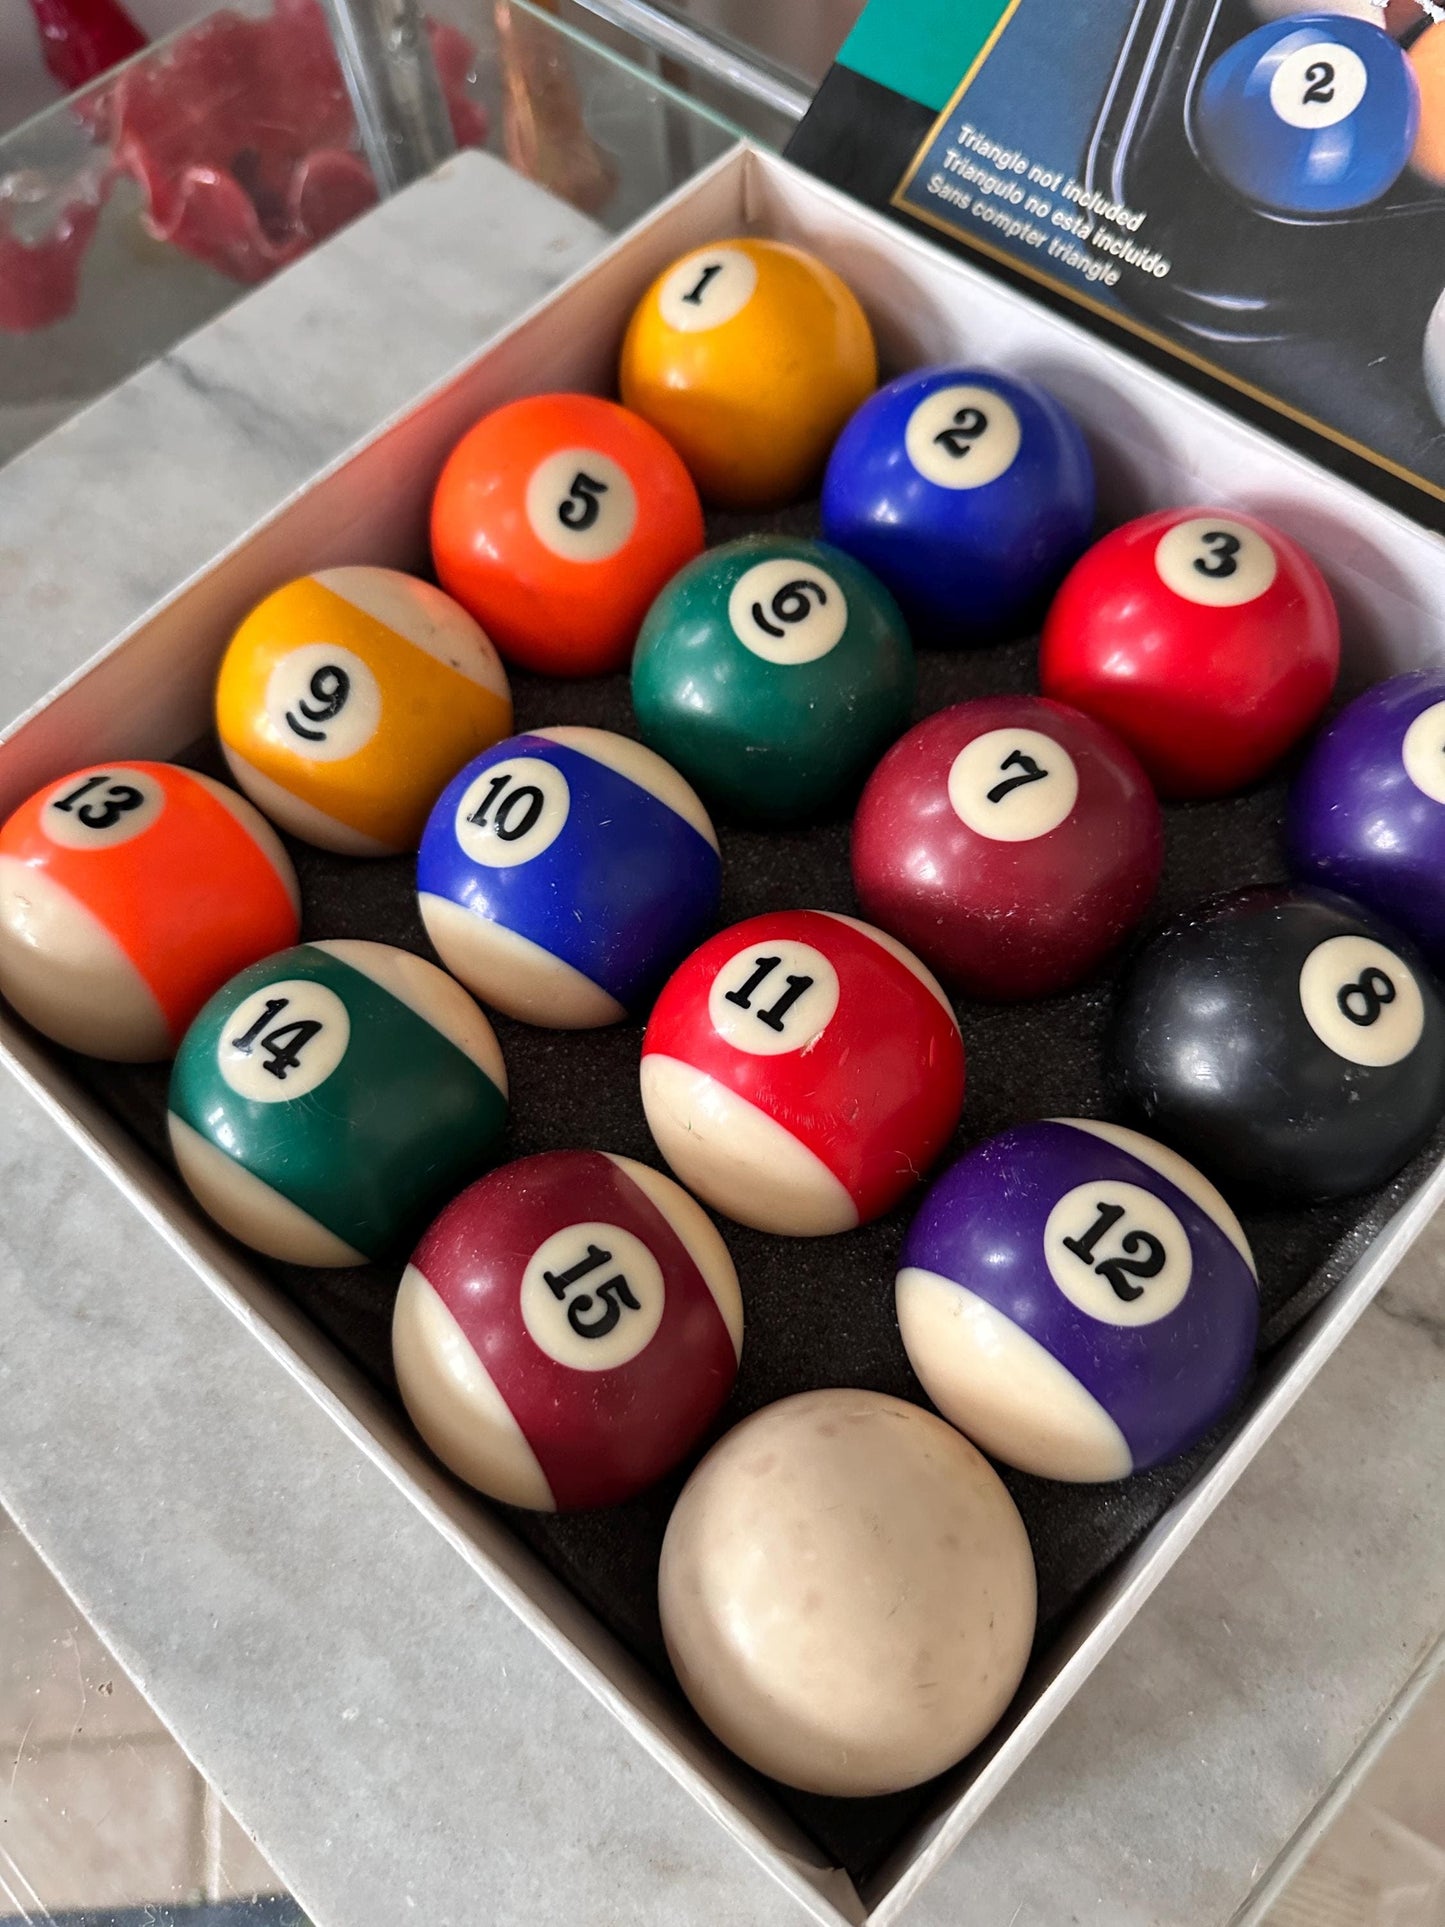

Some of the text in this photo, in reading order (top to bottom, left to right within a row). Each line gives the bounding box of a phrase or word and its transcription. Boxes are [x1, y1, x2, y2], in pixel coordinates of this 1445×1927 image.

[1303, 62, 1335, 104] 2
[957, 123, 1147, 232] Triangle not included
[927, 173, 1121, 286] Sans compter triangle
[943, 148, 1171, 278] Triangulo no esta incluido
[683, 264, 722, 304] 1
[933, 407, 989, 458] 2
[557, 471, 609, 532] 5
[1193, 531, 1242, 579] 3
[768, 578, 829, 627] 6
[297, 664, 351, 725] 9
[58, 775, 142, 830] 13
[986, 749, 1049, 804] 7
[470, 774, 545, 842] 10
[724, 956, 815, 1033] 11
[1336, 966, 1397, 1027] 8
[231, 998, 324, 1080] 14
[1062, 1201, 1167, 1303] 12
[542, 1243, 642, 1340] 15
